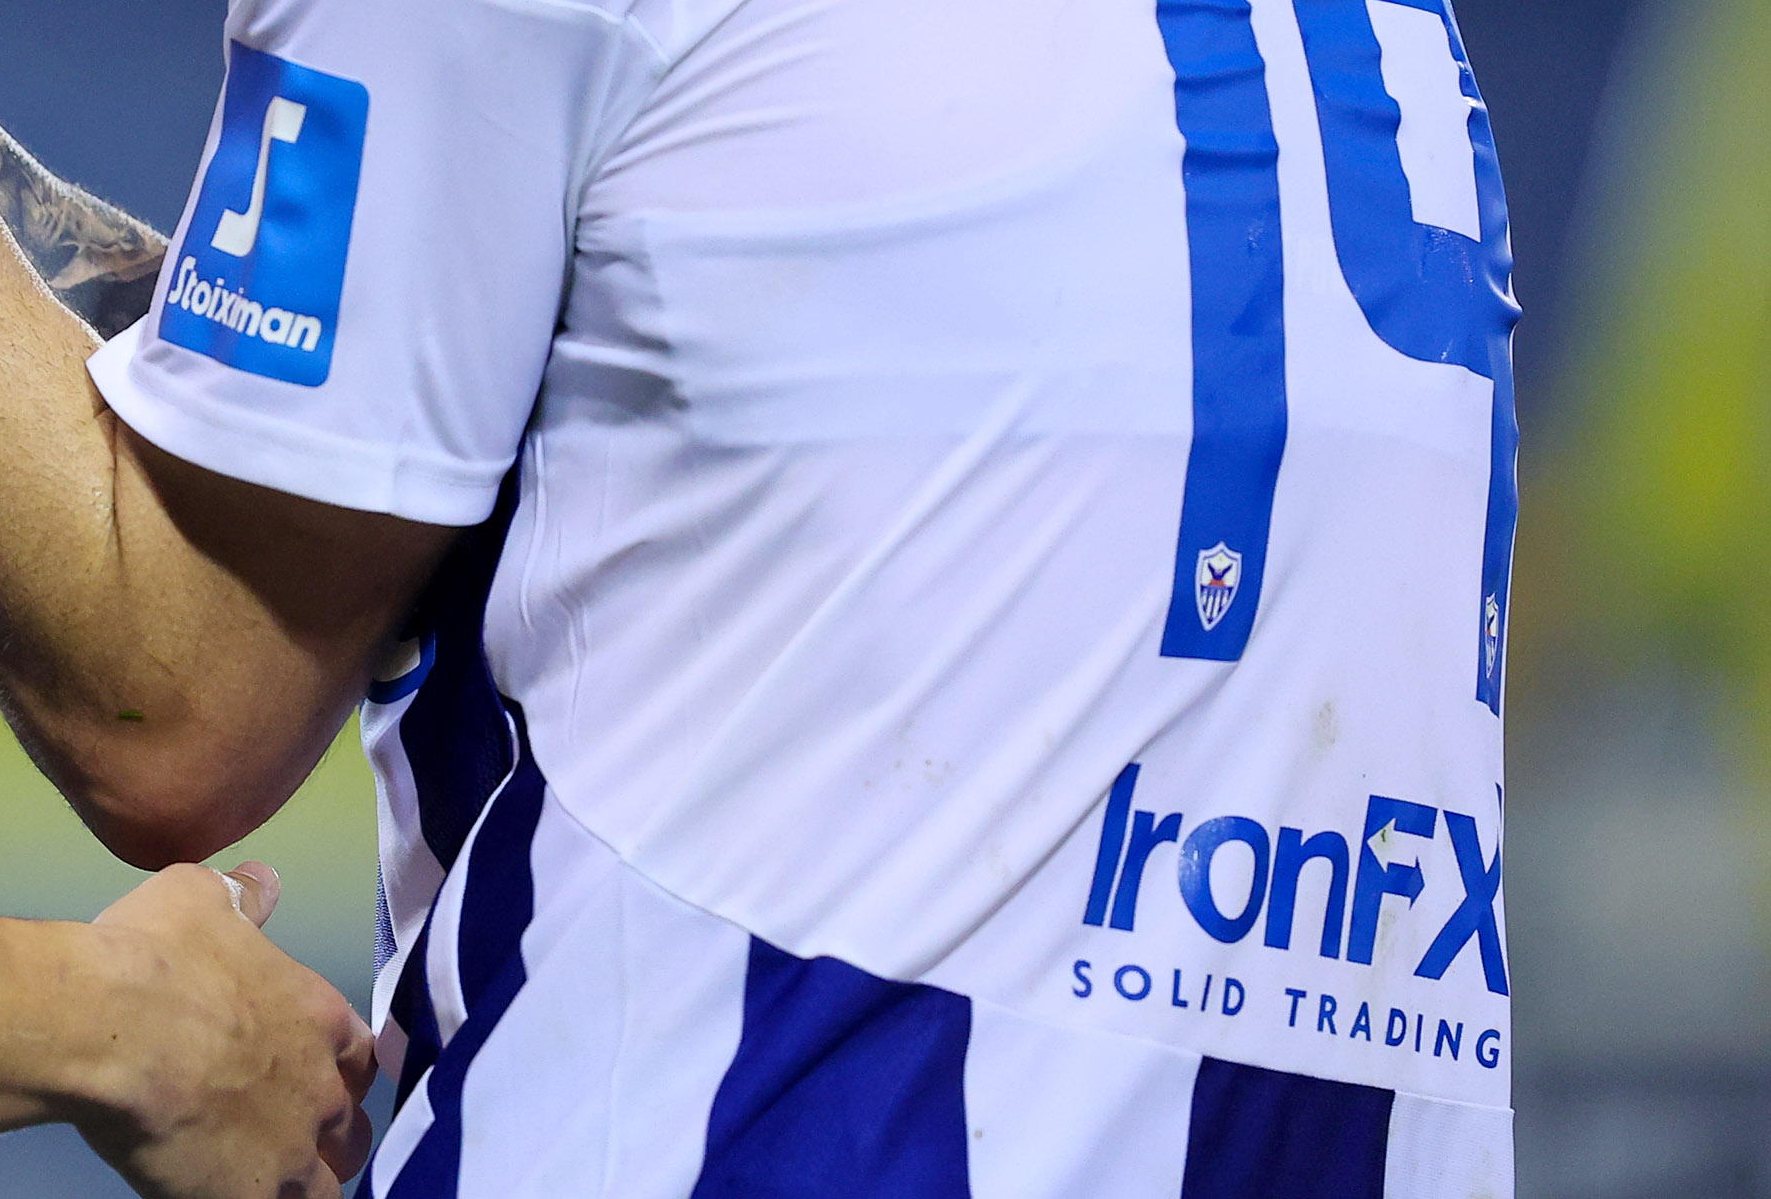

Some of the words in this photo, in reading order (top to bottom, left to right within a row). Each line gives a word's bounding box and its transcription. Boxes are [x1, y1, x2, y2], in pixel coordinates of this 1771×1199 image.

[167, 255, 323, 353] Stoixman
[1082, 762, 1511, 998] IronFX
[1072, 959, 1246, 1017] SOLID
[1285, 987, 1501, 1070] TRADING
